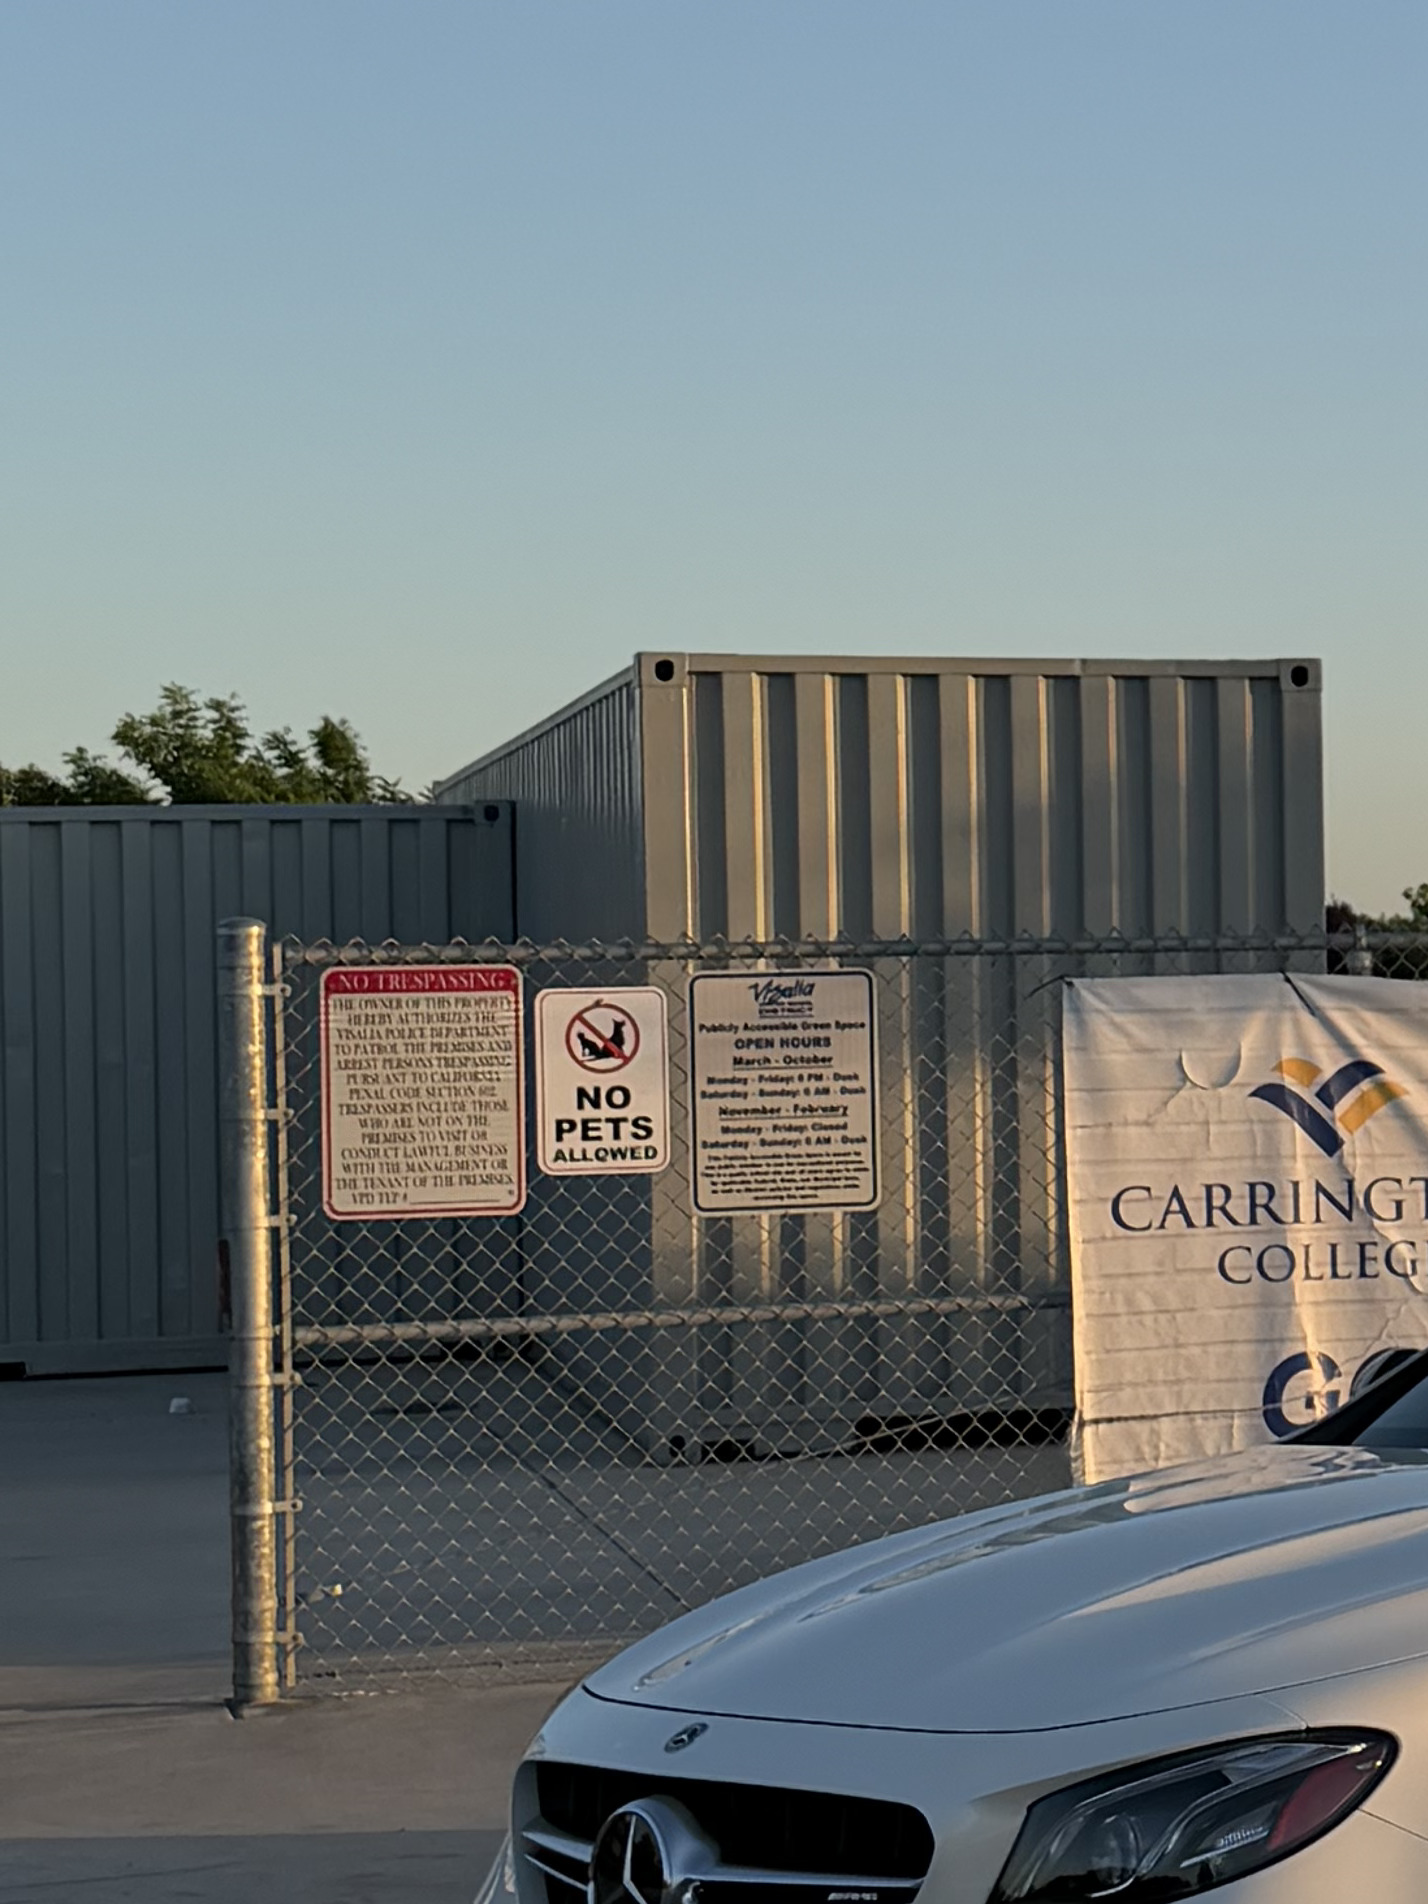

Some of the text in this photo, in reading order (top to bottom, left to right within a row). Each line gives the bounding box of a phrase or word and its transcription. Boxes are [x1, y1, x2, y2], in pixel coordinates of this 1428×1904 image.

[338, 971, 507, 990] NO TRESPASSING
[734, 1036, 832, 1050] OPEN HOURS
[733, 1055, 771, 1066] March
[783, 1054, 834, 1065] October
[576, 1085, 631, 1110] NO
[555, 1116, 653, 1142] PETS
[553, 1145, 658, 1163] ALLOWED
